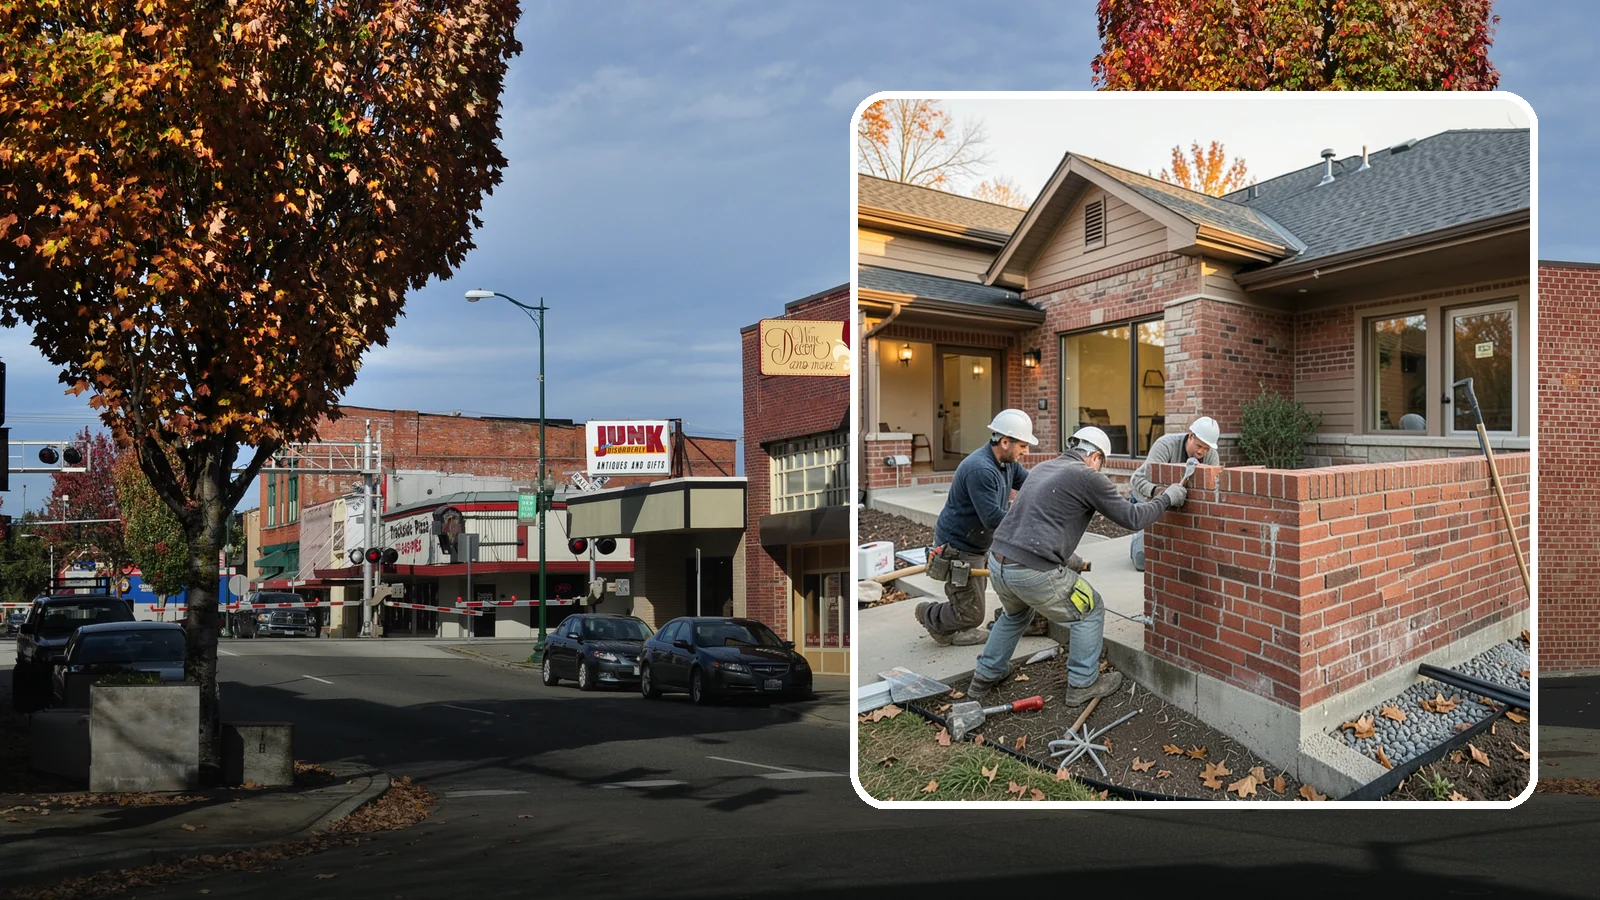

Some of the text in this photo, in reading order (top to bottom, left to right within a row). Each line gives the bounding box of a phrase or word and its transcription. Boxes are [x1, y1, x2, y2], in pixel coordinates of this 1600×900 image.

[595, 425, 666, 457] JUNK
[607, 445, 646, 454] DISORDERLY
[597, 460, 665, 470] ANTIQUES AND GIFTS
[390, 519, 429, 540] Trackside Pizza
